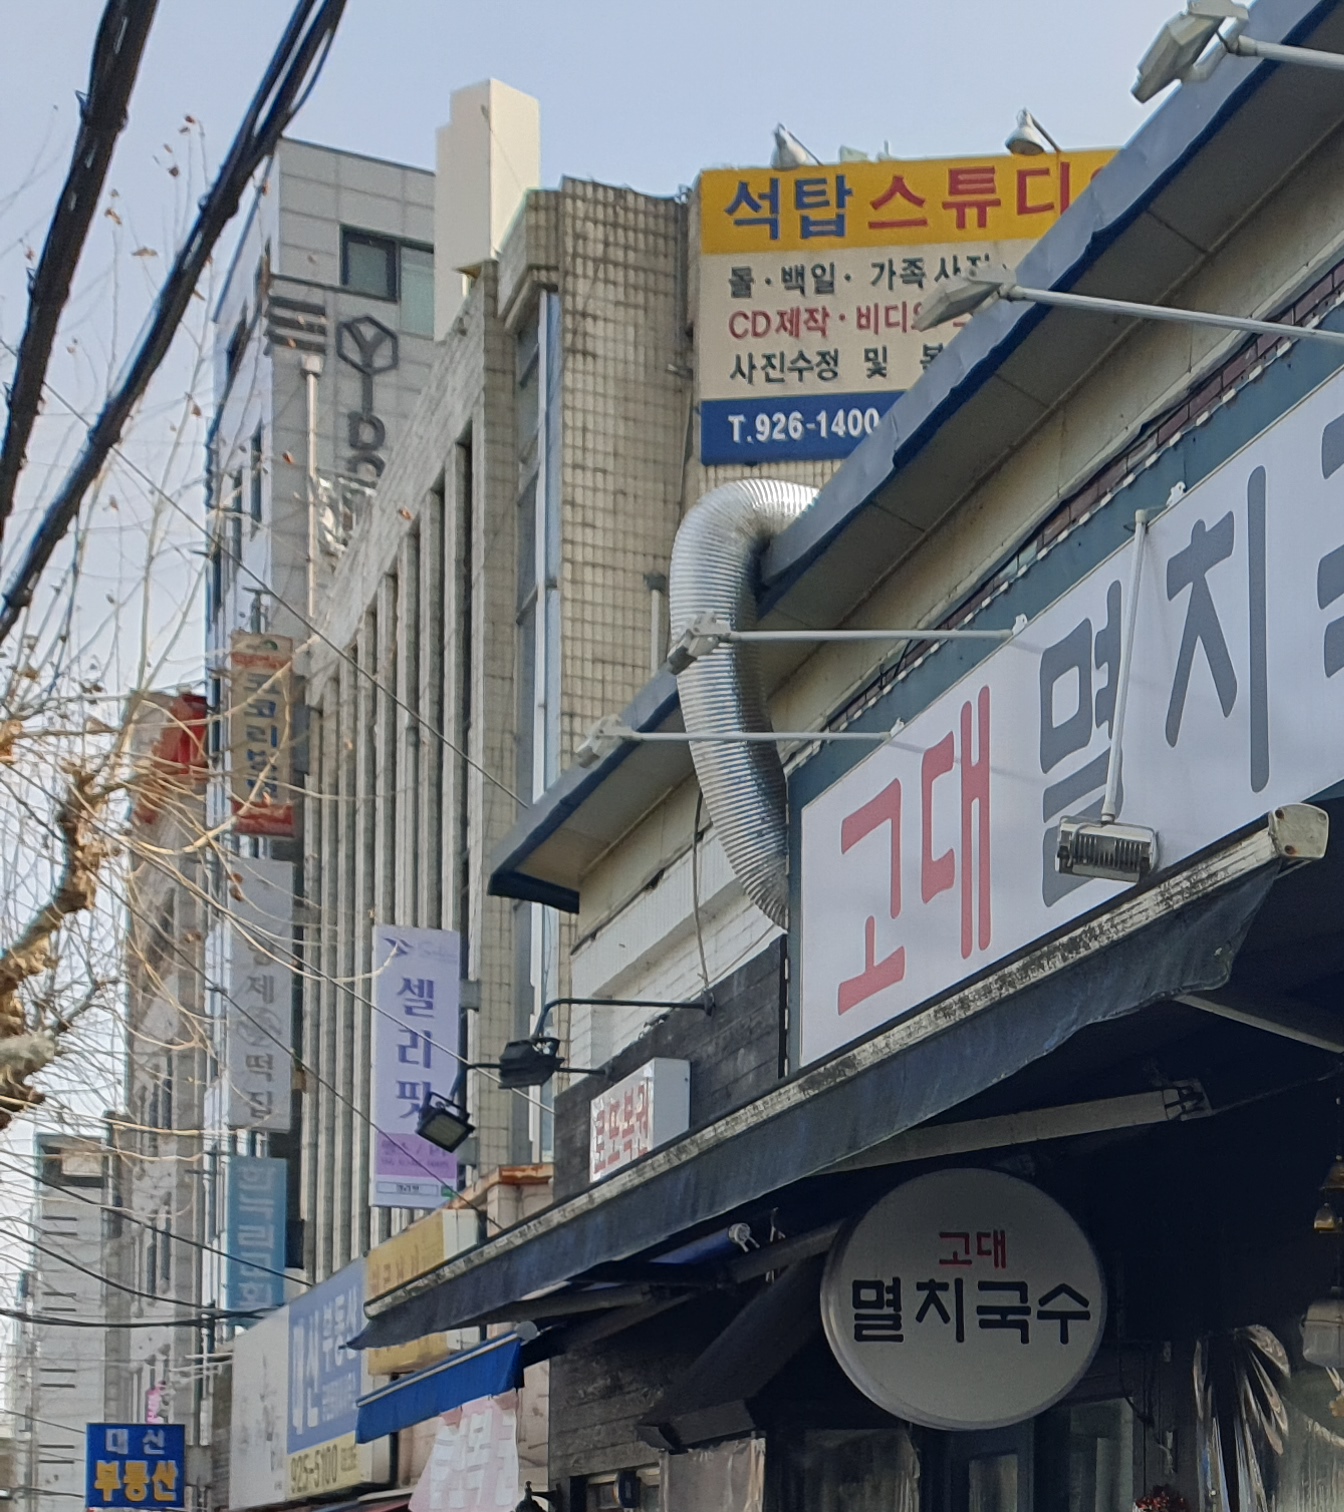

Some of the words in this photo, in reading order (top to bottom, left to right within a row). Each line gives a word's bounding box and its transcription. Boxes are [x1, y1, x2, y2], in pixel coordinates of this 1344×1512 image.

[729, 348, 840, 385] 사진수정
[863, 346, 888, 379] 및
[838, 684, 993, 1017] 고대
[939, 1230, 1007, 1269] 고대
[852, 1278, 1090, 1345] 멸치국수
[94, 1460, 179, 1501] 부동산
